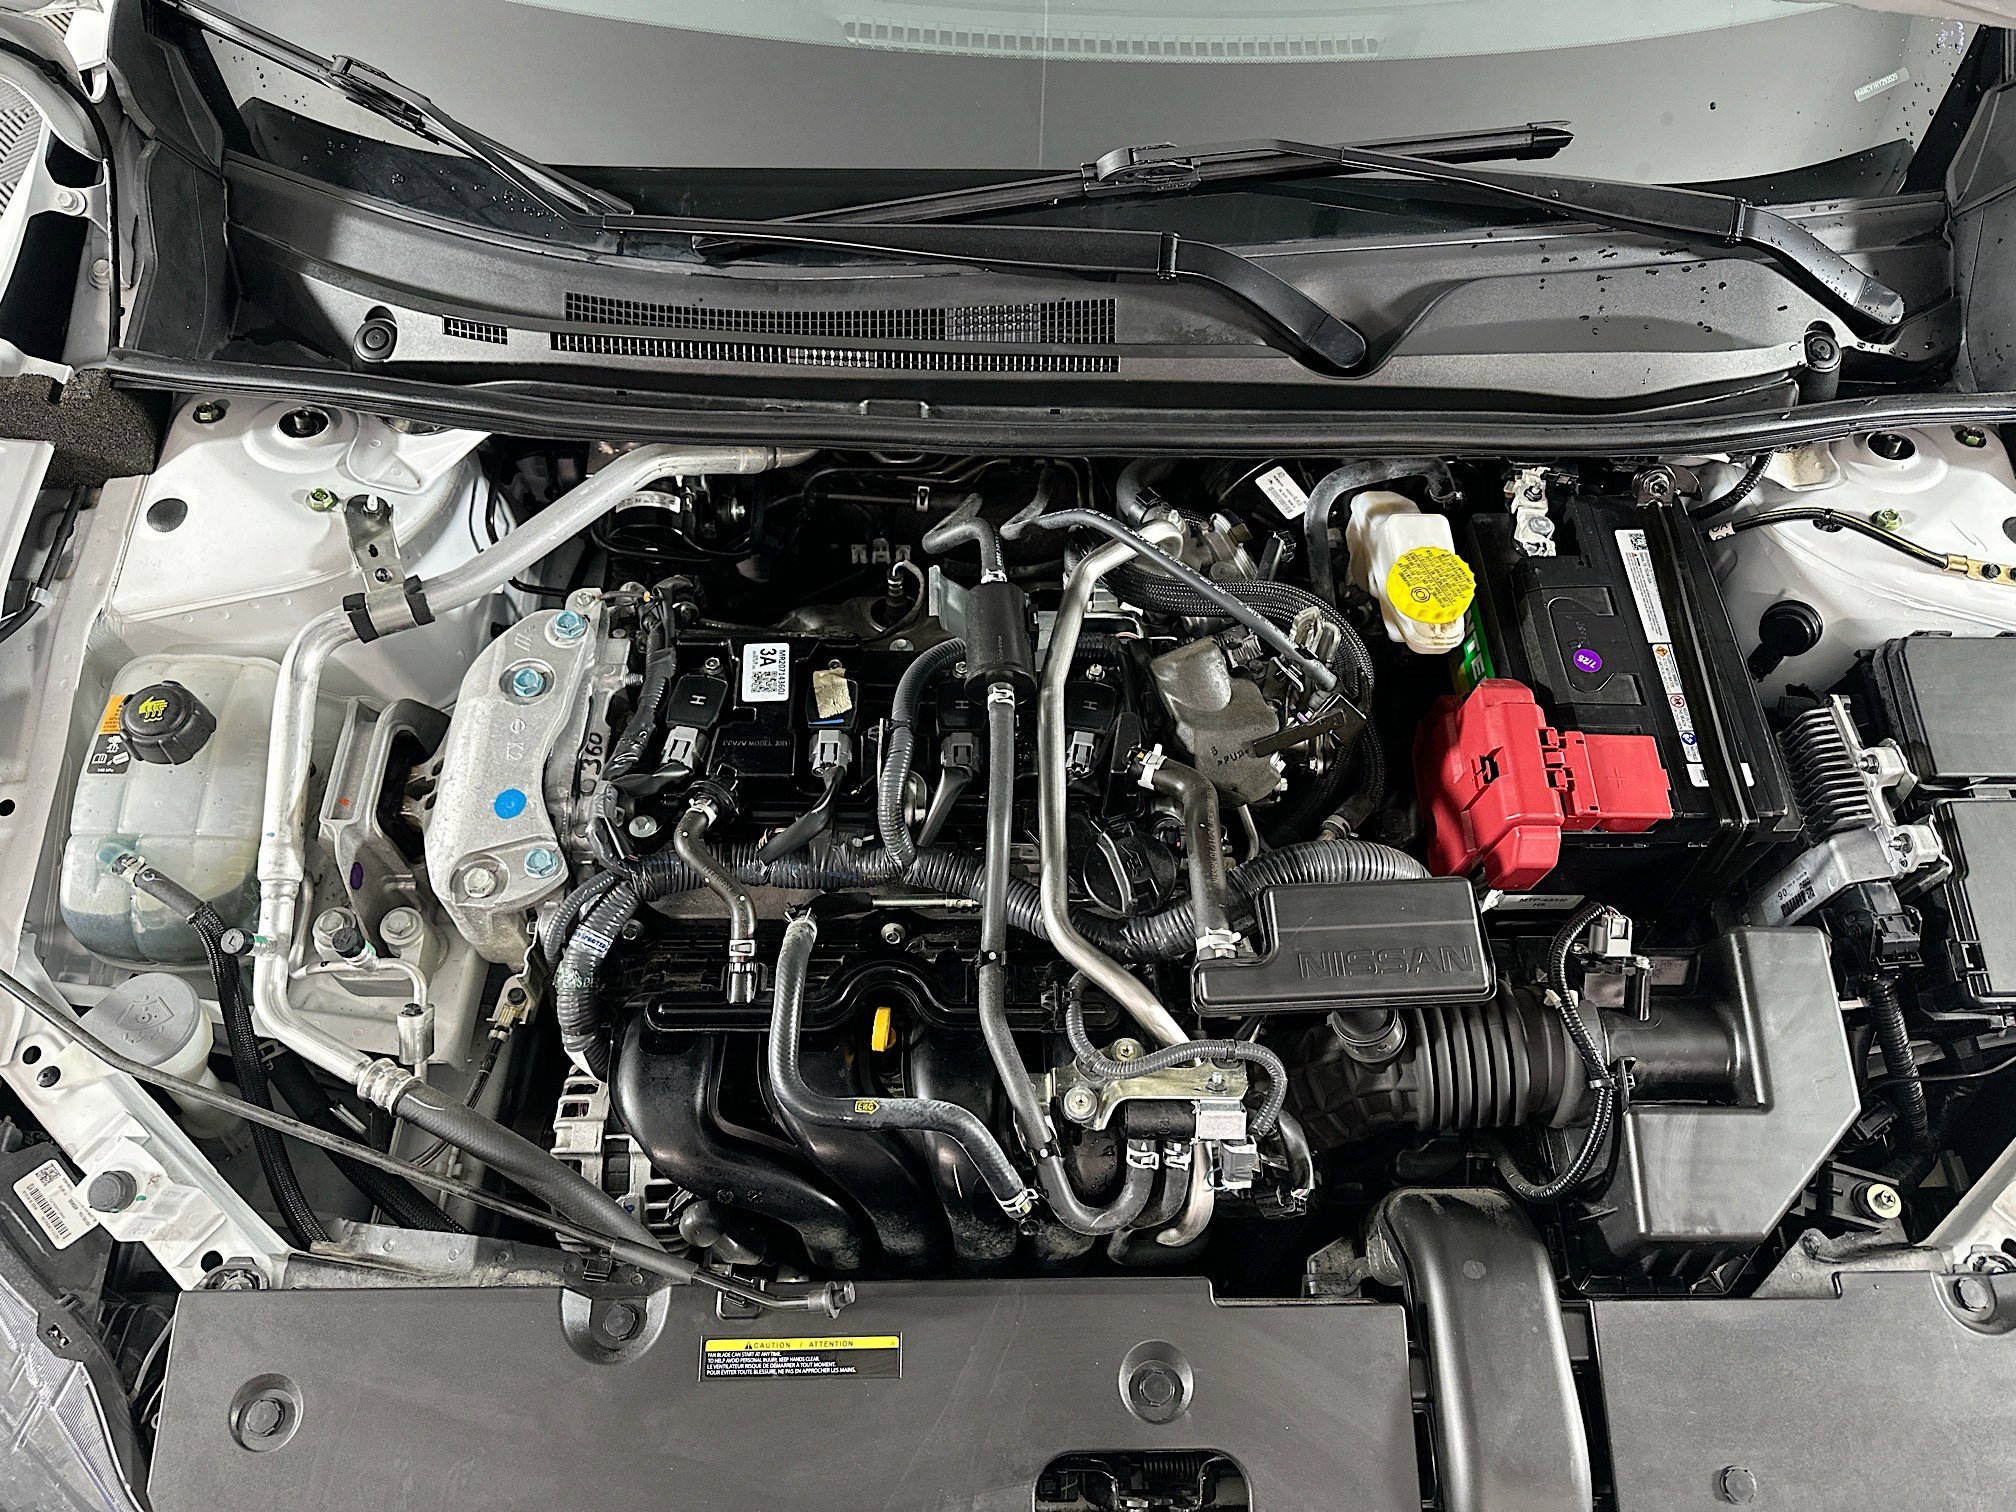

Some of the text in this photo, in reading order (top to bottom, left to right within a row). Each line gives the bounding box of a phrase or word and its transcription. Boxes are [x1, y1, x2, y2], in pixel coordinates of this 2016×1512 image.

[760, 648, 777, 667] 3A
[1577, 654, 1597, 669] 7/25
[507, 741, 524, 760] K2
[581, 732, 602, 775] 360
[702, 866, 733, 892] NISSAN
[1299, 945, 1476, 979] NISSAN
